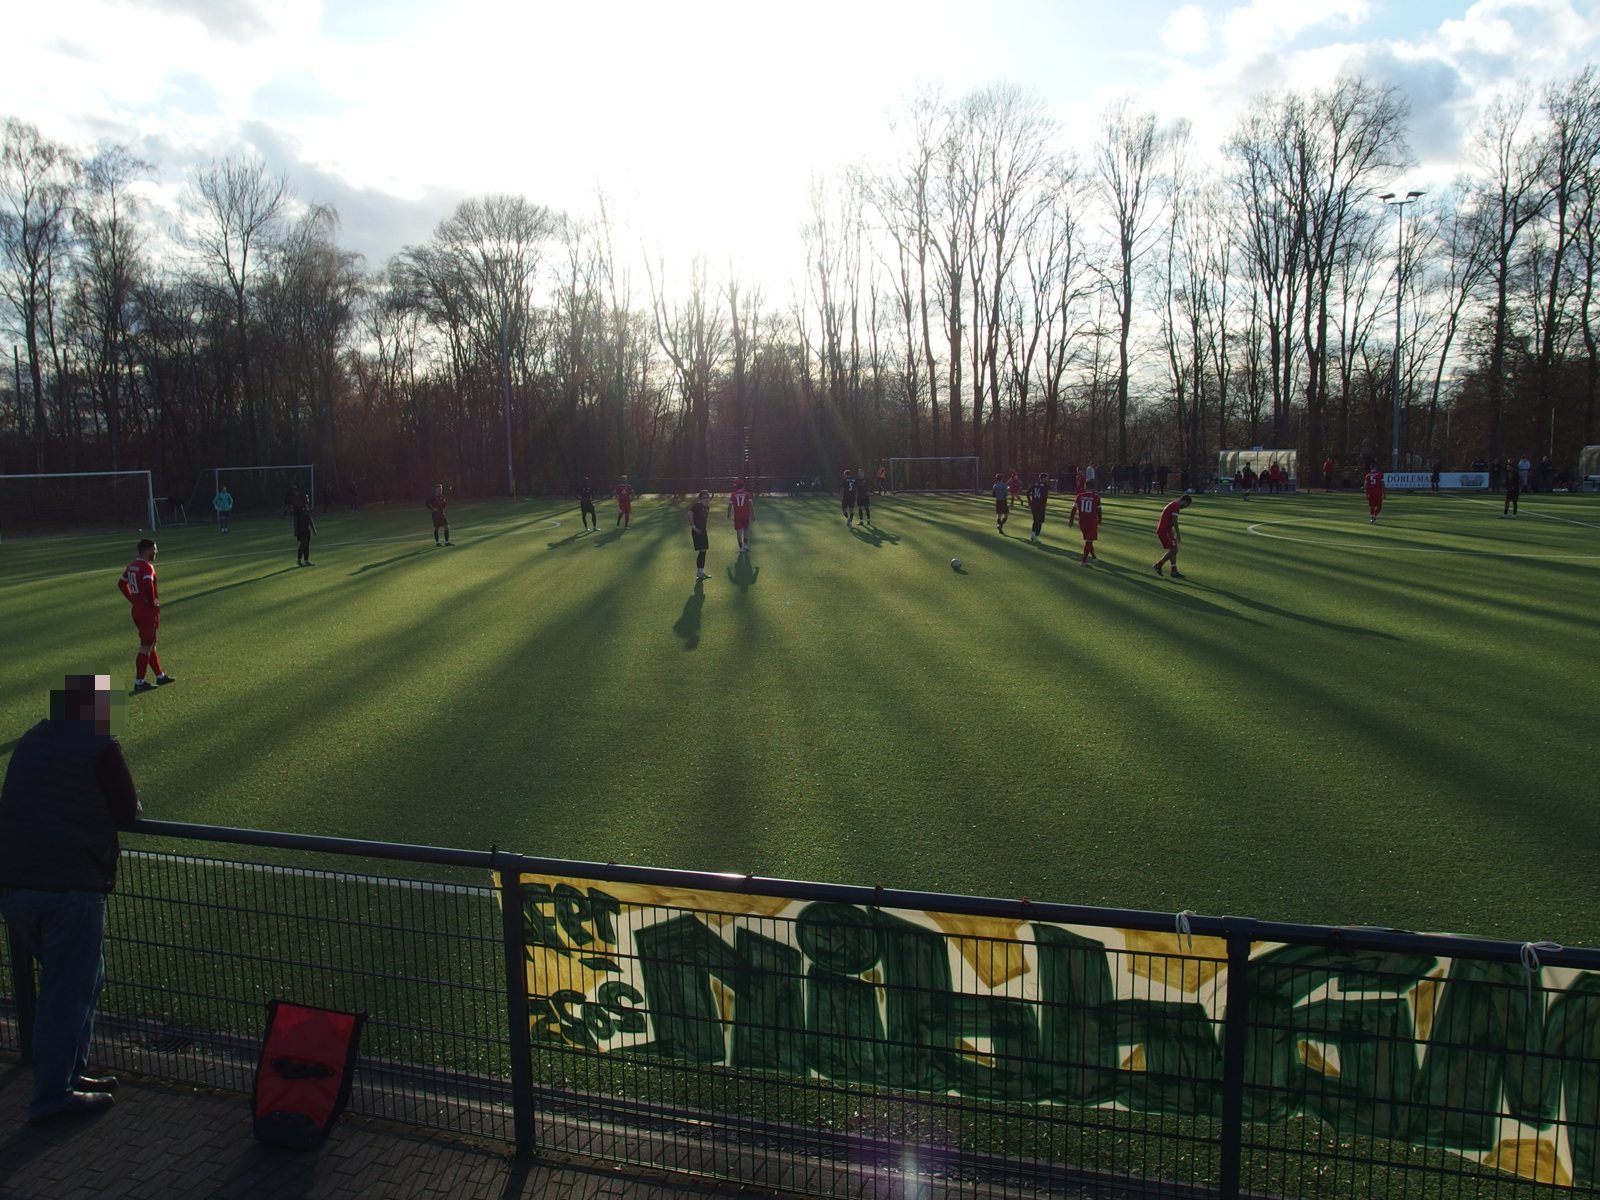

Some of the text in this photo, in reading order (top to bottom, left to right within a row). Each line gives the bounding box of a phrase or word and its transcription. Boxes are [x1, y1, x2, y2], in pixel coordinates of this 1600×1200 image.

[1370, 475, 1377, 485] 5
[1033, 488, 1041, 499] 14
[736, 494, 746, 507] 17
[1080, 499, 1093, 513] 10
[128, 572, 139, 594] 19
